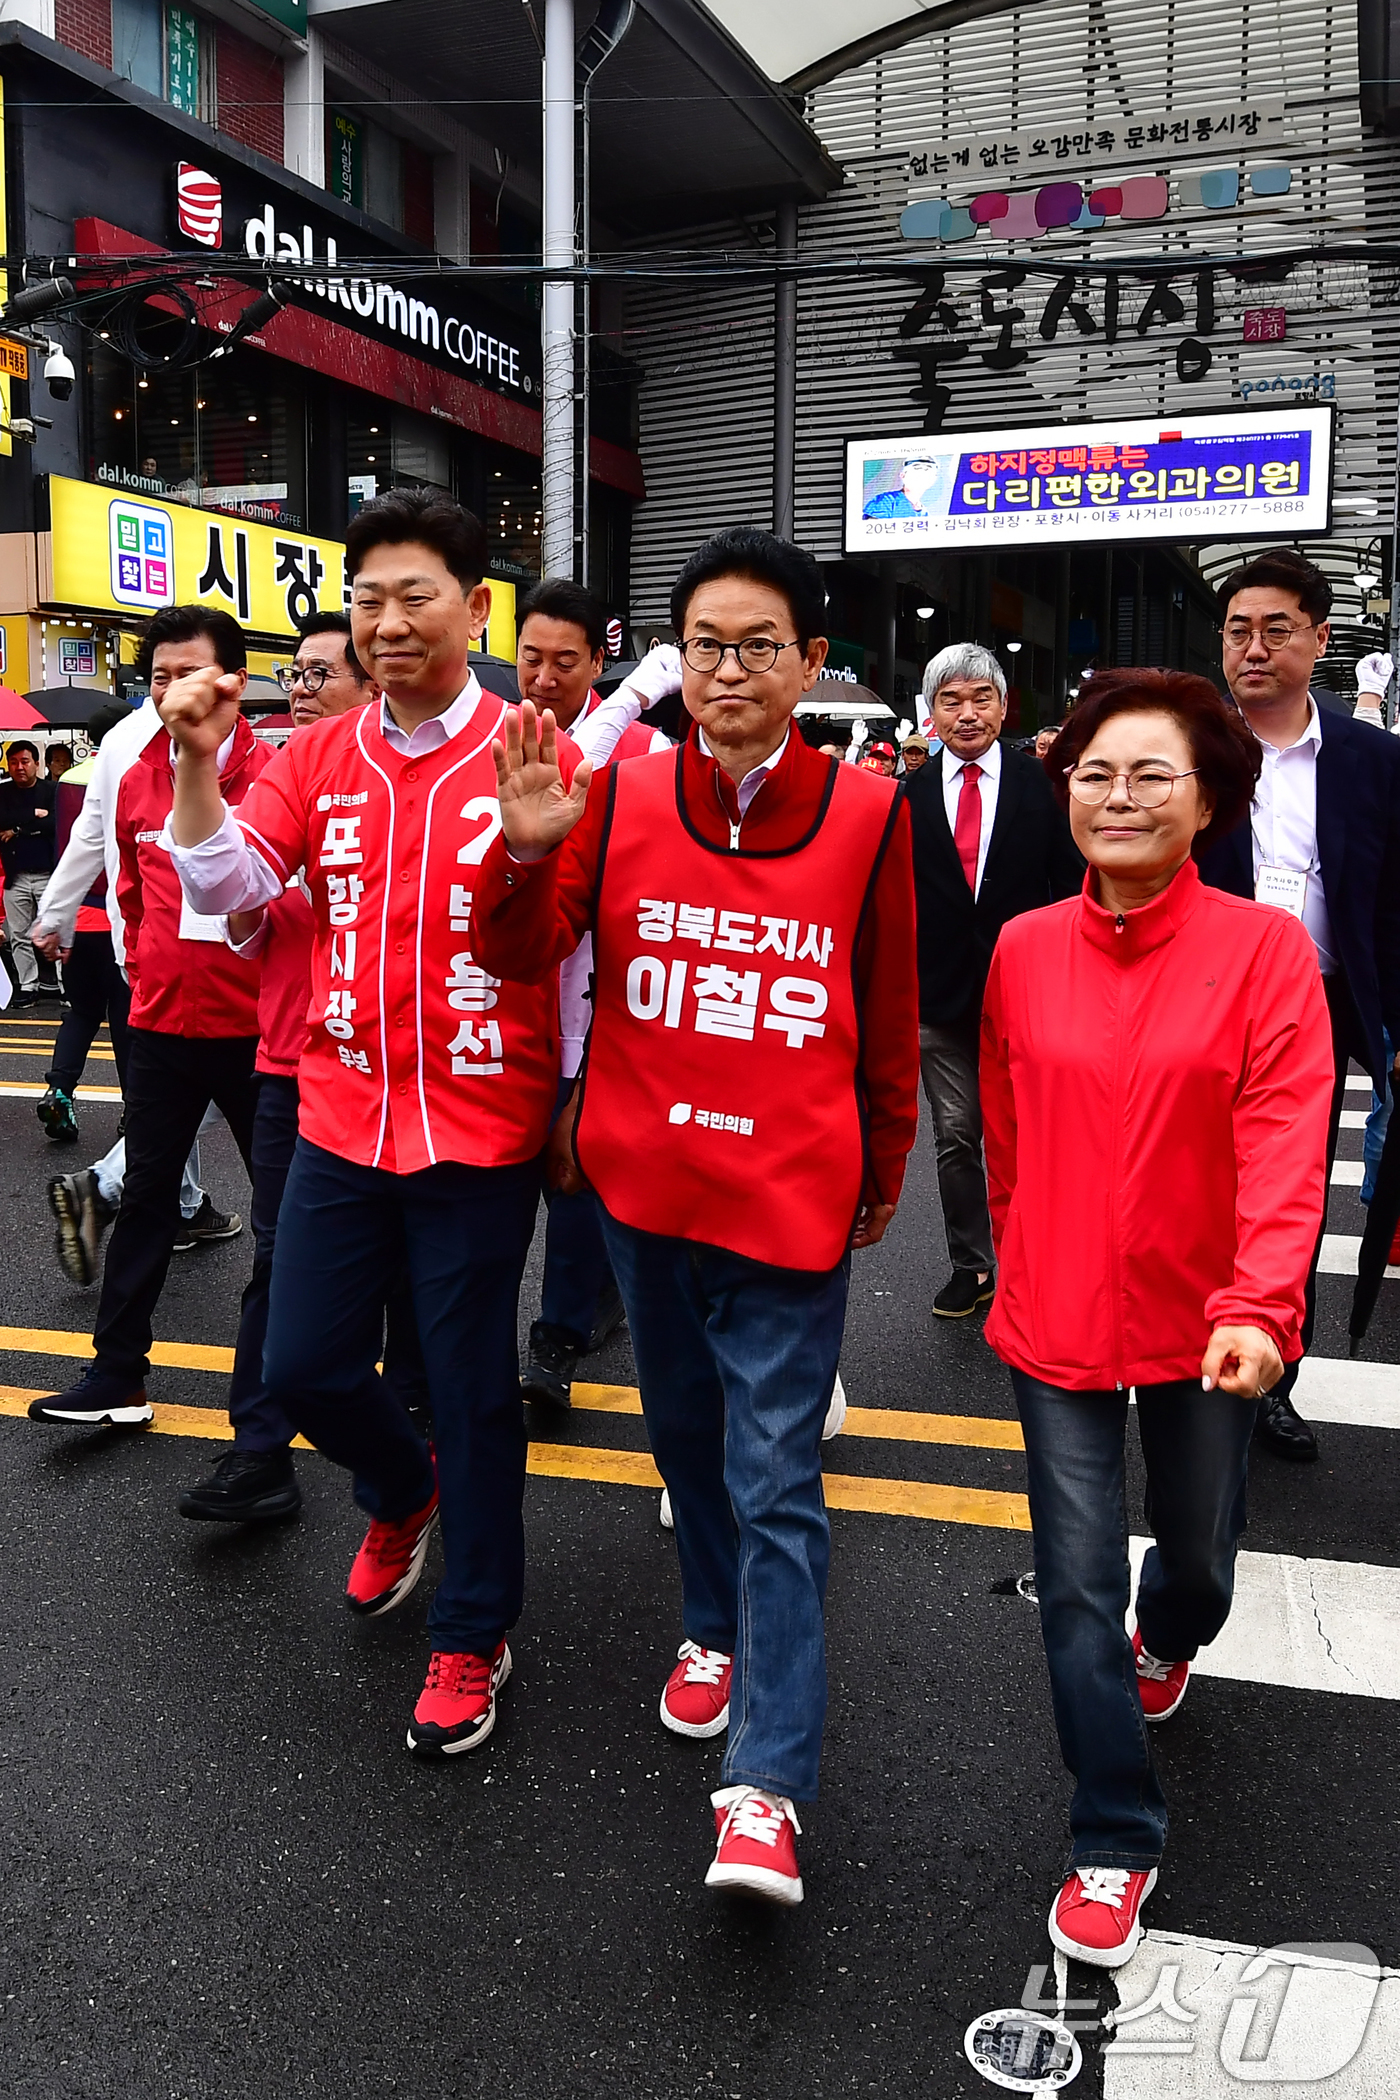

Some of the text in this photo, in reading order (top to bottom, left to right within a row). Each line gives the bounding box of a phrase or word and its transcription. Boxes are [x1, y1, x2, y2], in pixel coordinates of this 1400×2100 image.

[335, 117, 356, 139] 예수
[909, 111, 1261, 176] 없는게 없는 오감만족 문화전통시장
[245, 203, 520, 388] dal.komm COFFEE
[1246, 323, 1282, 339] 시장
[1247, 311, 1282, 326] 죽도
[98, 461, 163, 493] dal.komm
[969, 444, 1150, 477] 하지정맥류는
[962, 460, 1301, 512] 다리편한외과의원
[220, 494, 301, 528] dal.komm COFFEE
[866, 520, 896, 535] 20년
[902, 520, 930, 534] 경력
[992, 515, 1021, 528] 원장
[1034, 512, 1080, 526] 포항시
[1091, 509, 1121, 522] 이동
[1126, 507, 1173, 521] 사거리
[1178, 501, 1305, 518] (054)277-5888
[120, 520, 164, 553] 믿고
[121, 557, 166, 593] 찾는
[490, 556, 523, 575] dal.komm
[64, 641, 93, 656] 믿고
[64, 659, 93, 672] 찾는
[332, 790, 369, 807] 국민의힘
[456, 795, 504, 866] 2
[318, 815, 365, 1040] 포항시장
[636, 898, 835, 969] 경북도지사
[626, 955, 829, 1050] 이철우
[336, 1044, 373, 1074] 후보
[694, 1108, 755, 1137] 국민의힘
